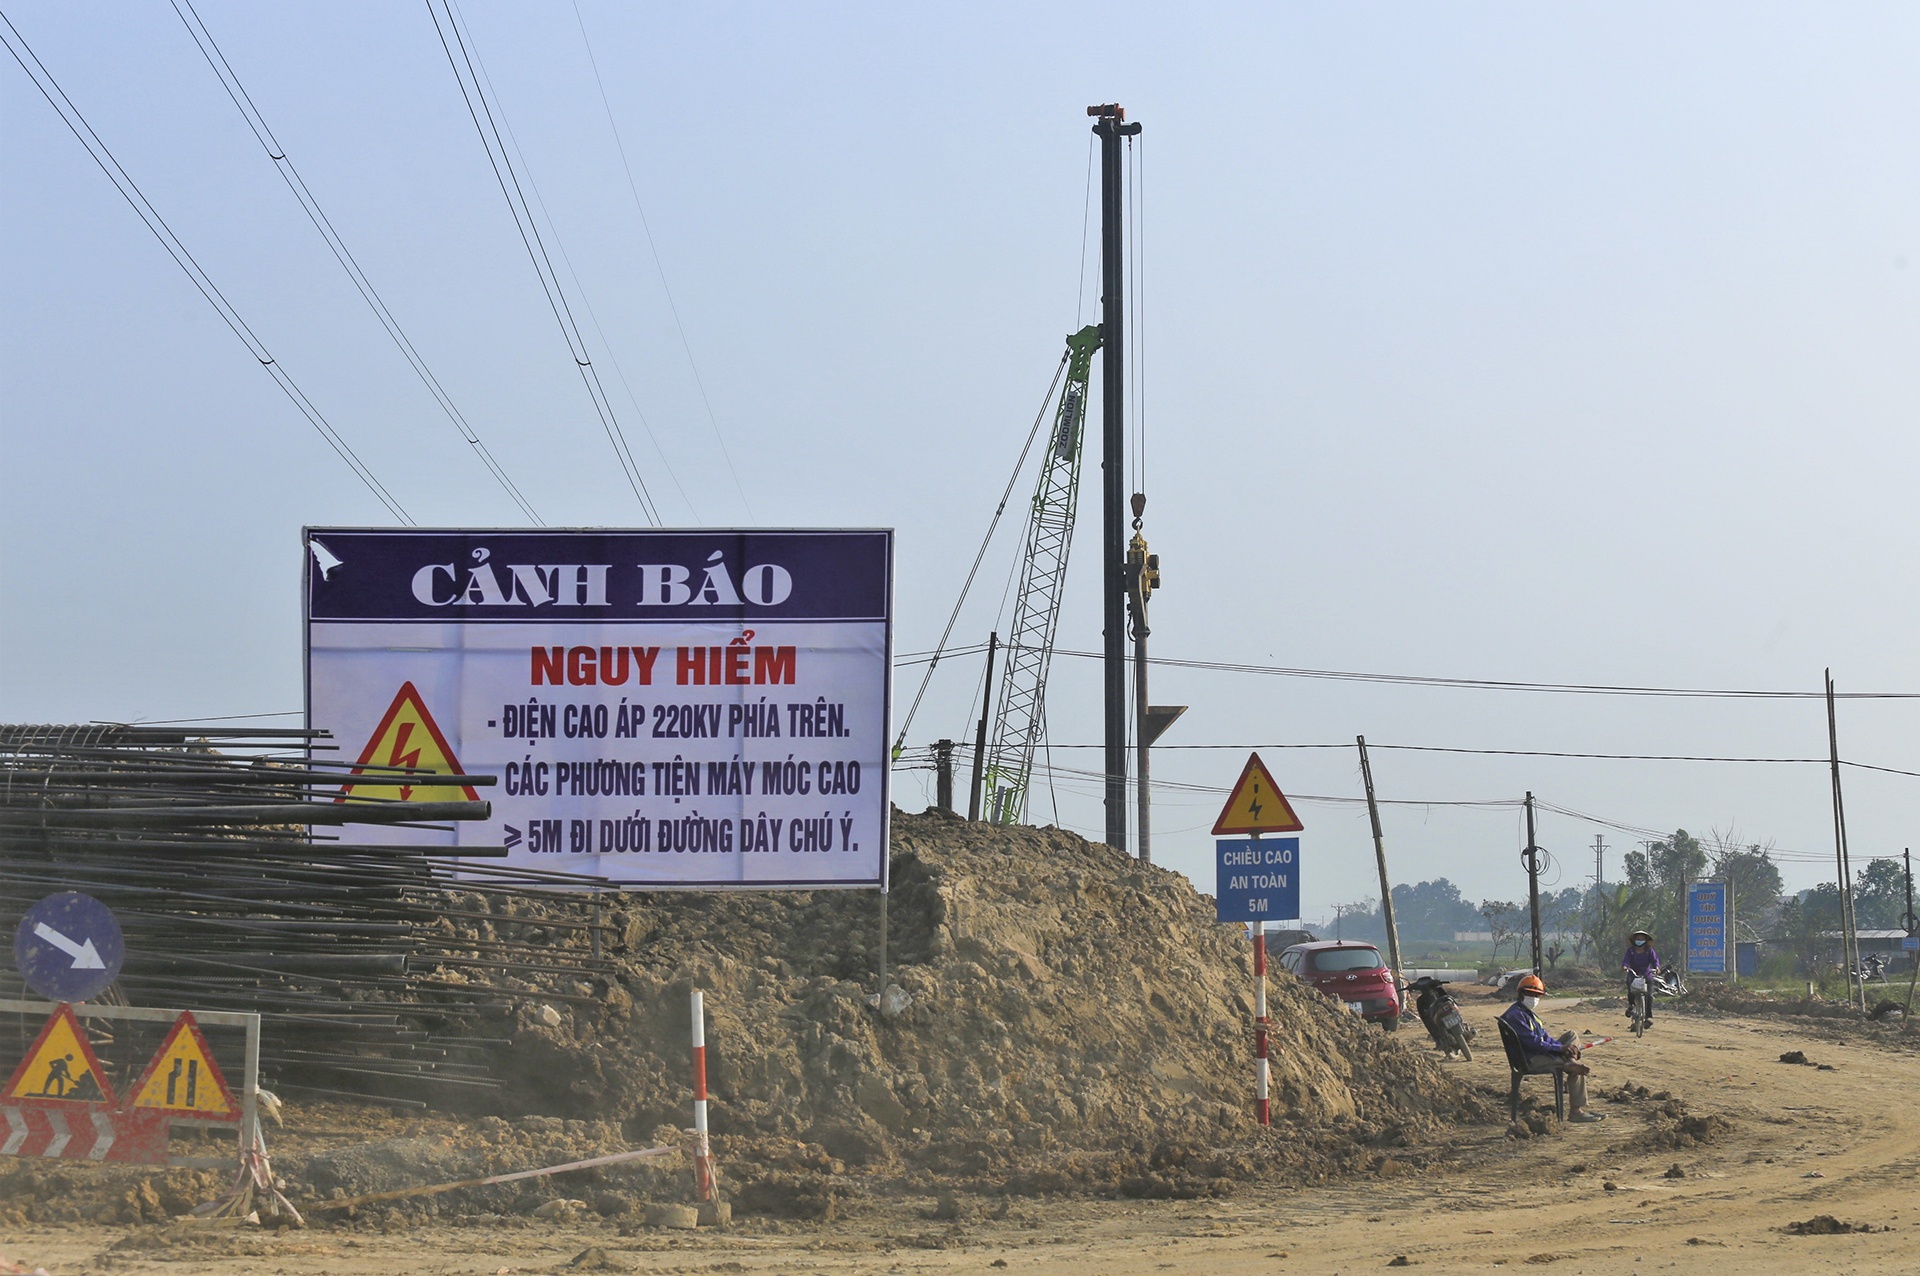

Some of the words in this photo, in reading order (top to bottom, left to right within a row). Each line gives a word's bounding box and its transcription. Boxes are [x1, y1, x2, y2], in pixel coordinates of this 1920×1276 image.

[1059, 394, 1076, 448] ZOOMLION
[411, 547, 612, 608] CẢNH
[636, 550, 793, 607] BÁO
[531, 645, 661, 686] NGUY
[676, 629, 796, 686] HIỂM
[503, 697, 556, 746] ĐIỆN
[564, 704, 609, 739] CAO
[615, 697, 646, 739] ÁP
[652, 704, 722, 739] 220KV
[728, 696, 781, 738] PHÍA
[787, 696, 850, 738] TRÊN.
[505, 754, 549, 796] CÁC
[556, 758, 646, 796] PHƯƠNG
[652, 754, 700, 804] TIỆN
[707, 754, 755, 796] MÁY
[762, 754, 811, 796] MÓC
[818, 760, 861, 795] CAO
[570, 819, 593, 853] ĐI
[600, 809, 651, 853] DƯỚI
[658, 810, 733, 853] ĐƯỜNG
[740, 811, 783, 853] DÂY
[789, 811, 833, 853] CHÚ
[840, 811, 859, 852] Ý.
[1223, 845, 1261, 865] CHIỀU
[1265, 849, 1292, 865] CAO
[1229, 875, 1249, 890] AN
[1251, 871, 1287, 889] TOÀN
[1249, 898, 1268, 913] 5M
